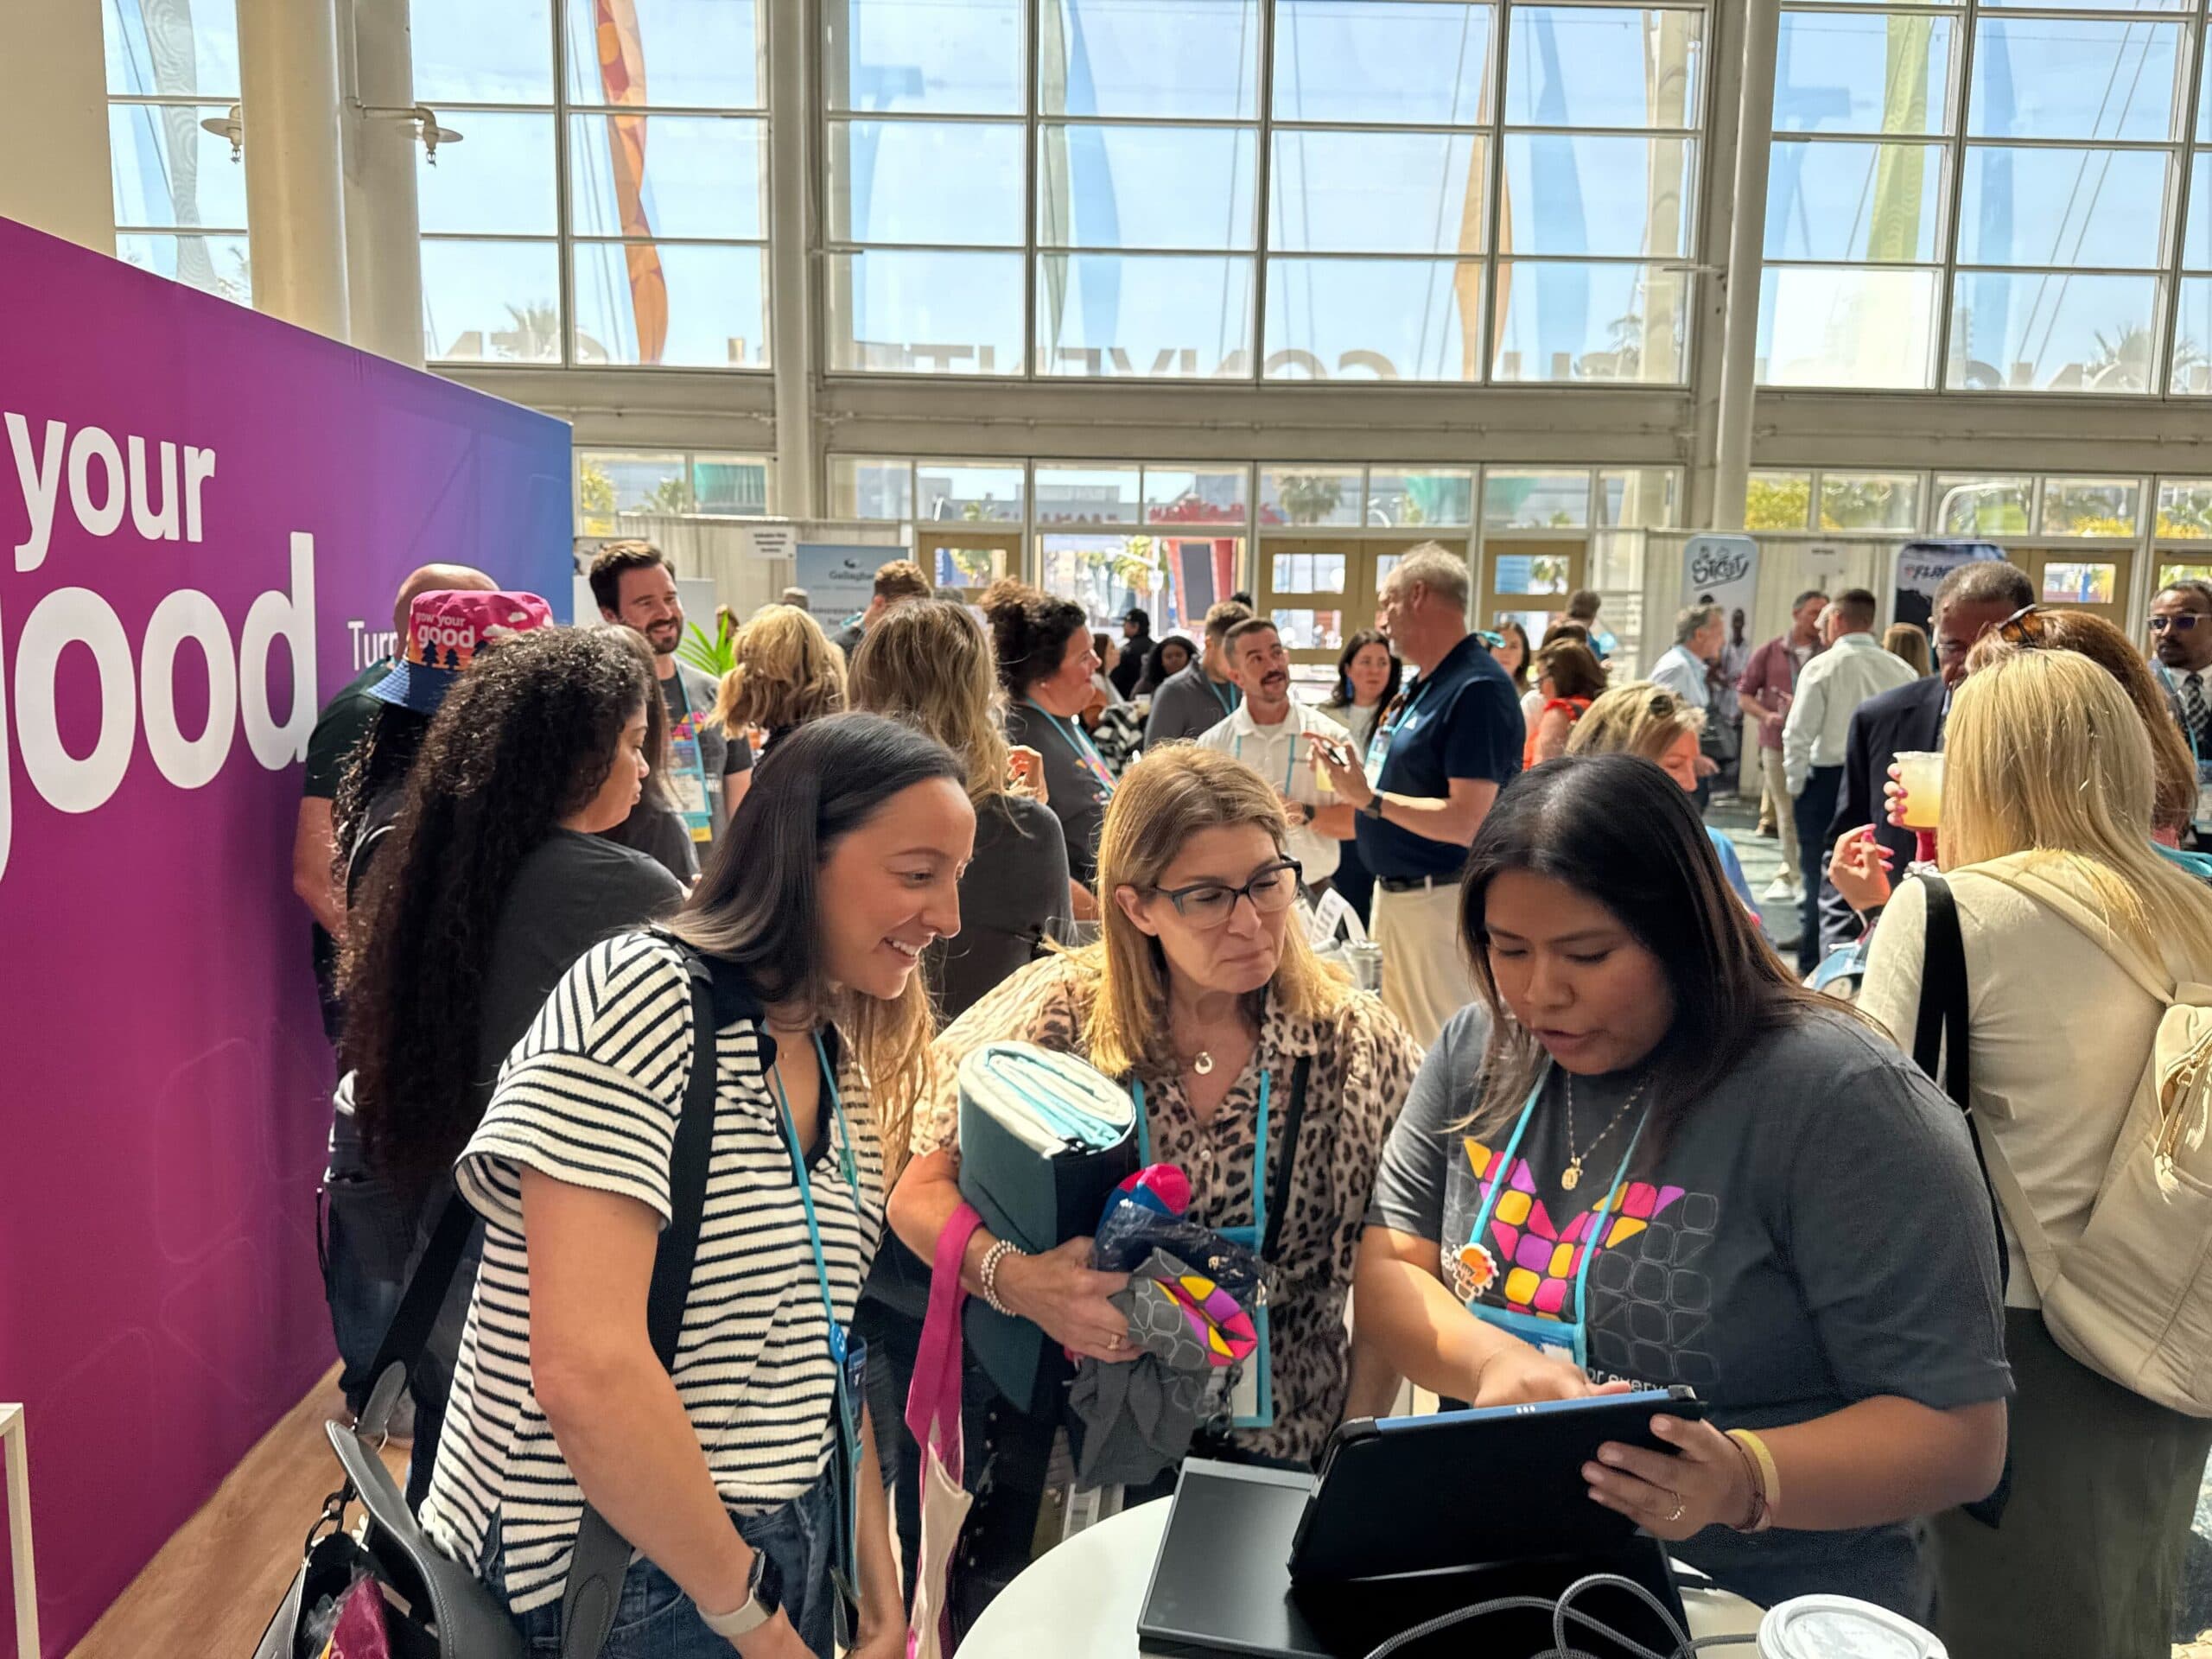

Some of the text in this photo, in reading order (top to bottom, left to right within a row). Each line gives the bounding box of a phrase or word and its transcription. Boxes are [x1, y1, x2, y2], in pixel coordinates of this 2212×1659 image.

[3, 411, 216, 572] your
[417, 625, 474, 649] good
[437, 615, 466, 627] your
[0, 531, 318, 883] ood
